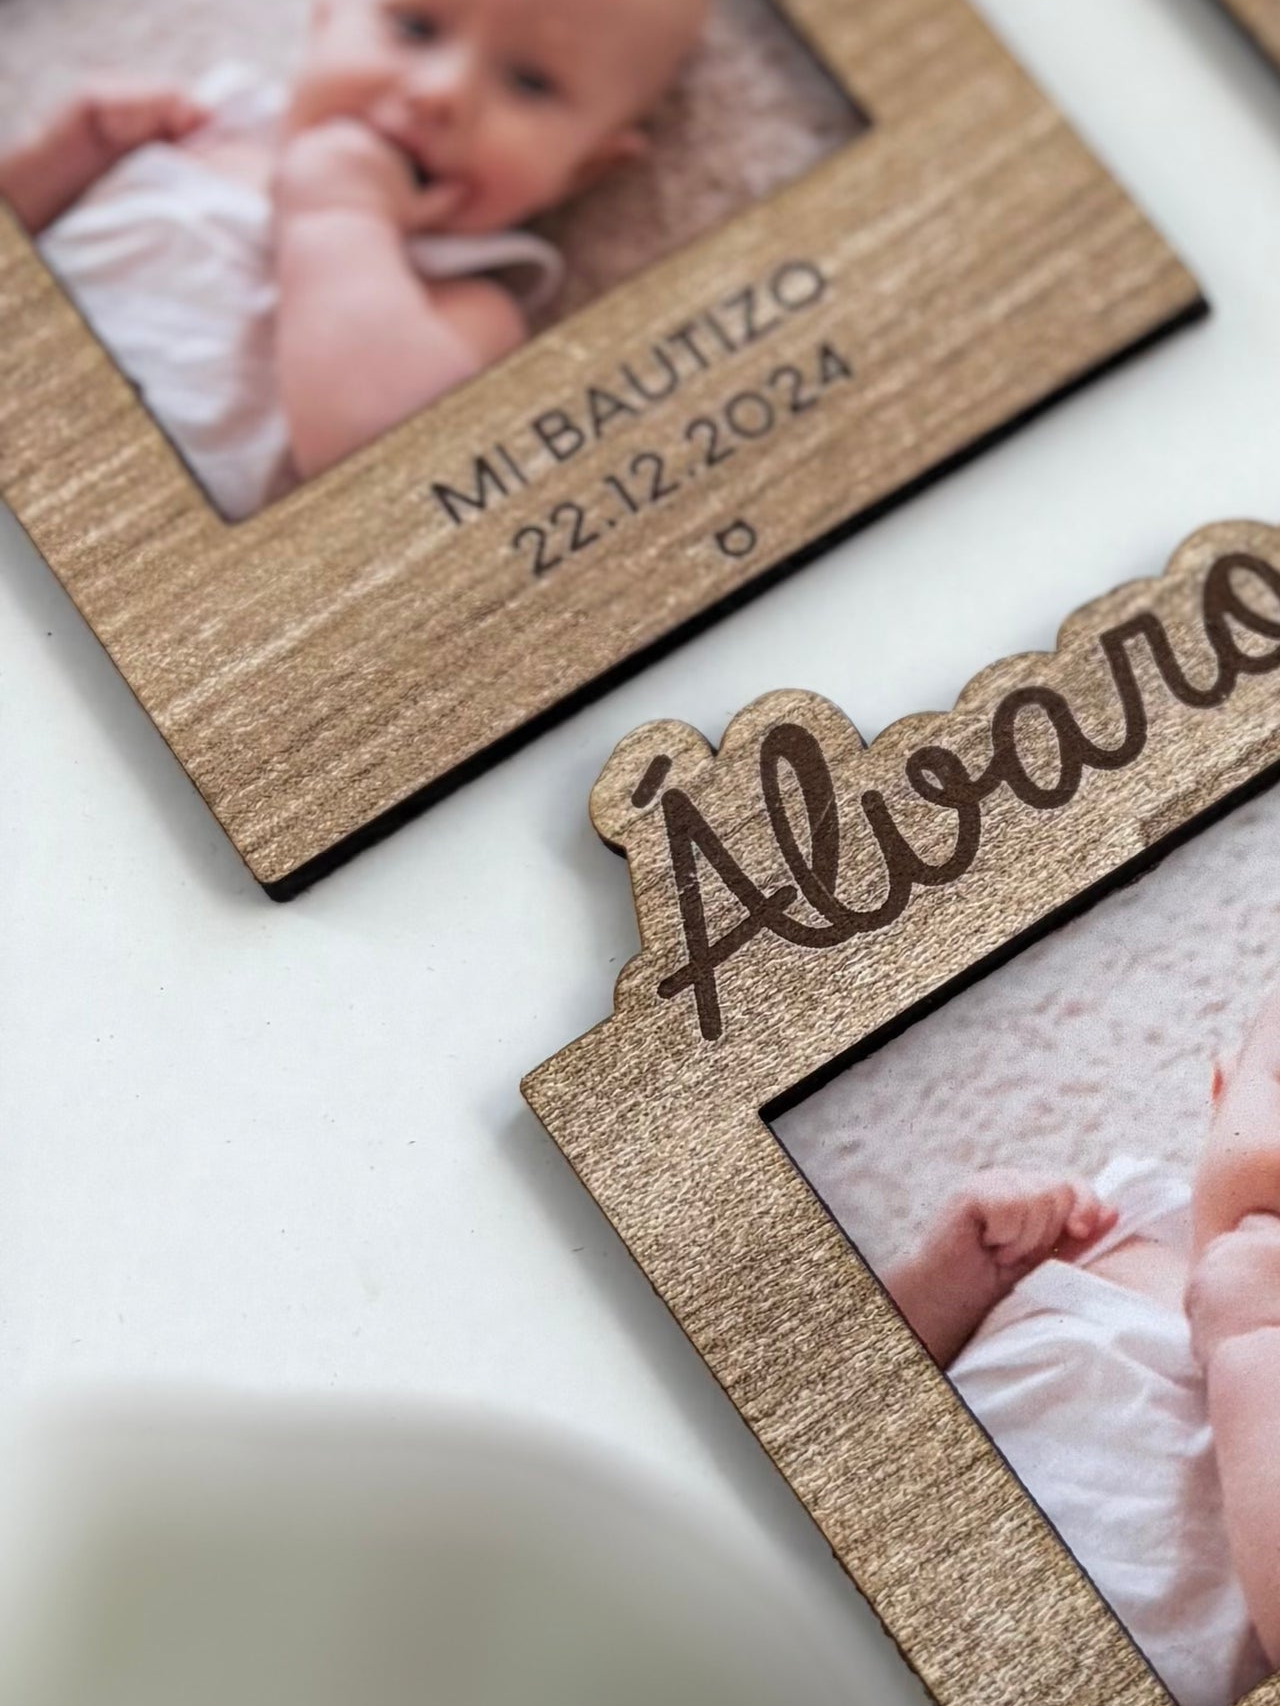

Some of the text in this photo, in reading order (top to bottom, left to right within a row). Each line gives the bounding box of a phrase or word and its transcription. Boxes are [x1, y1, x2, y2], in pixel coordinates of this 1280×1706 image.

[430, 260, 829, 526] MI BAUTIZO
[512, 343, 853, 578] 22.12.2024
